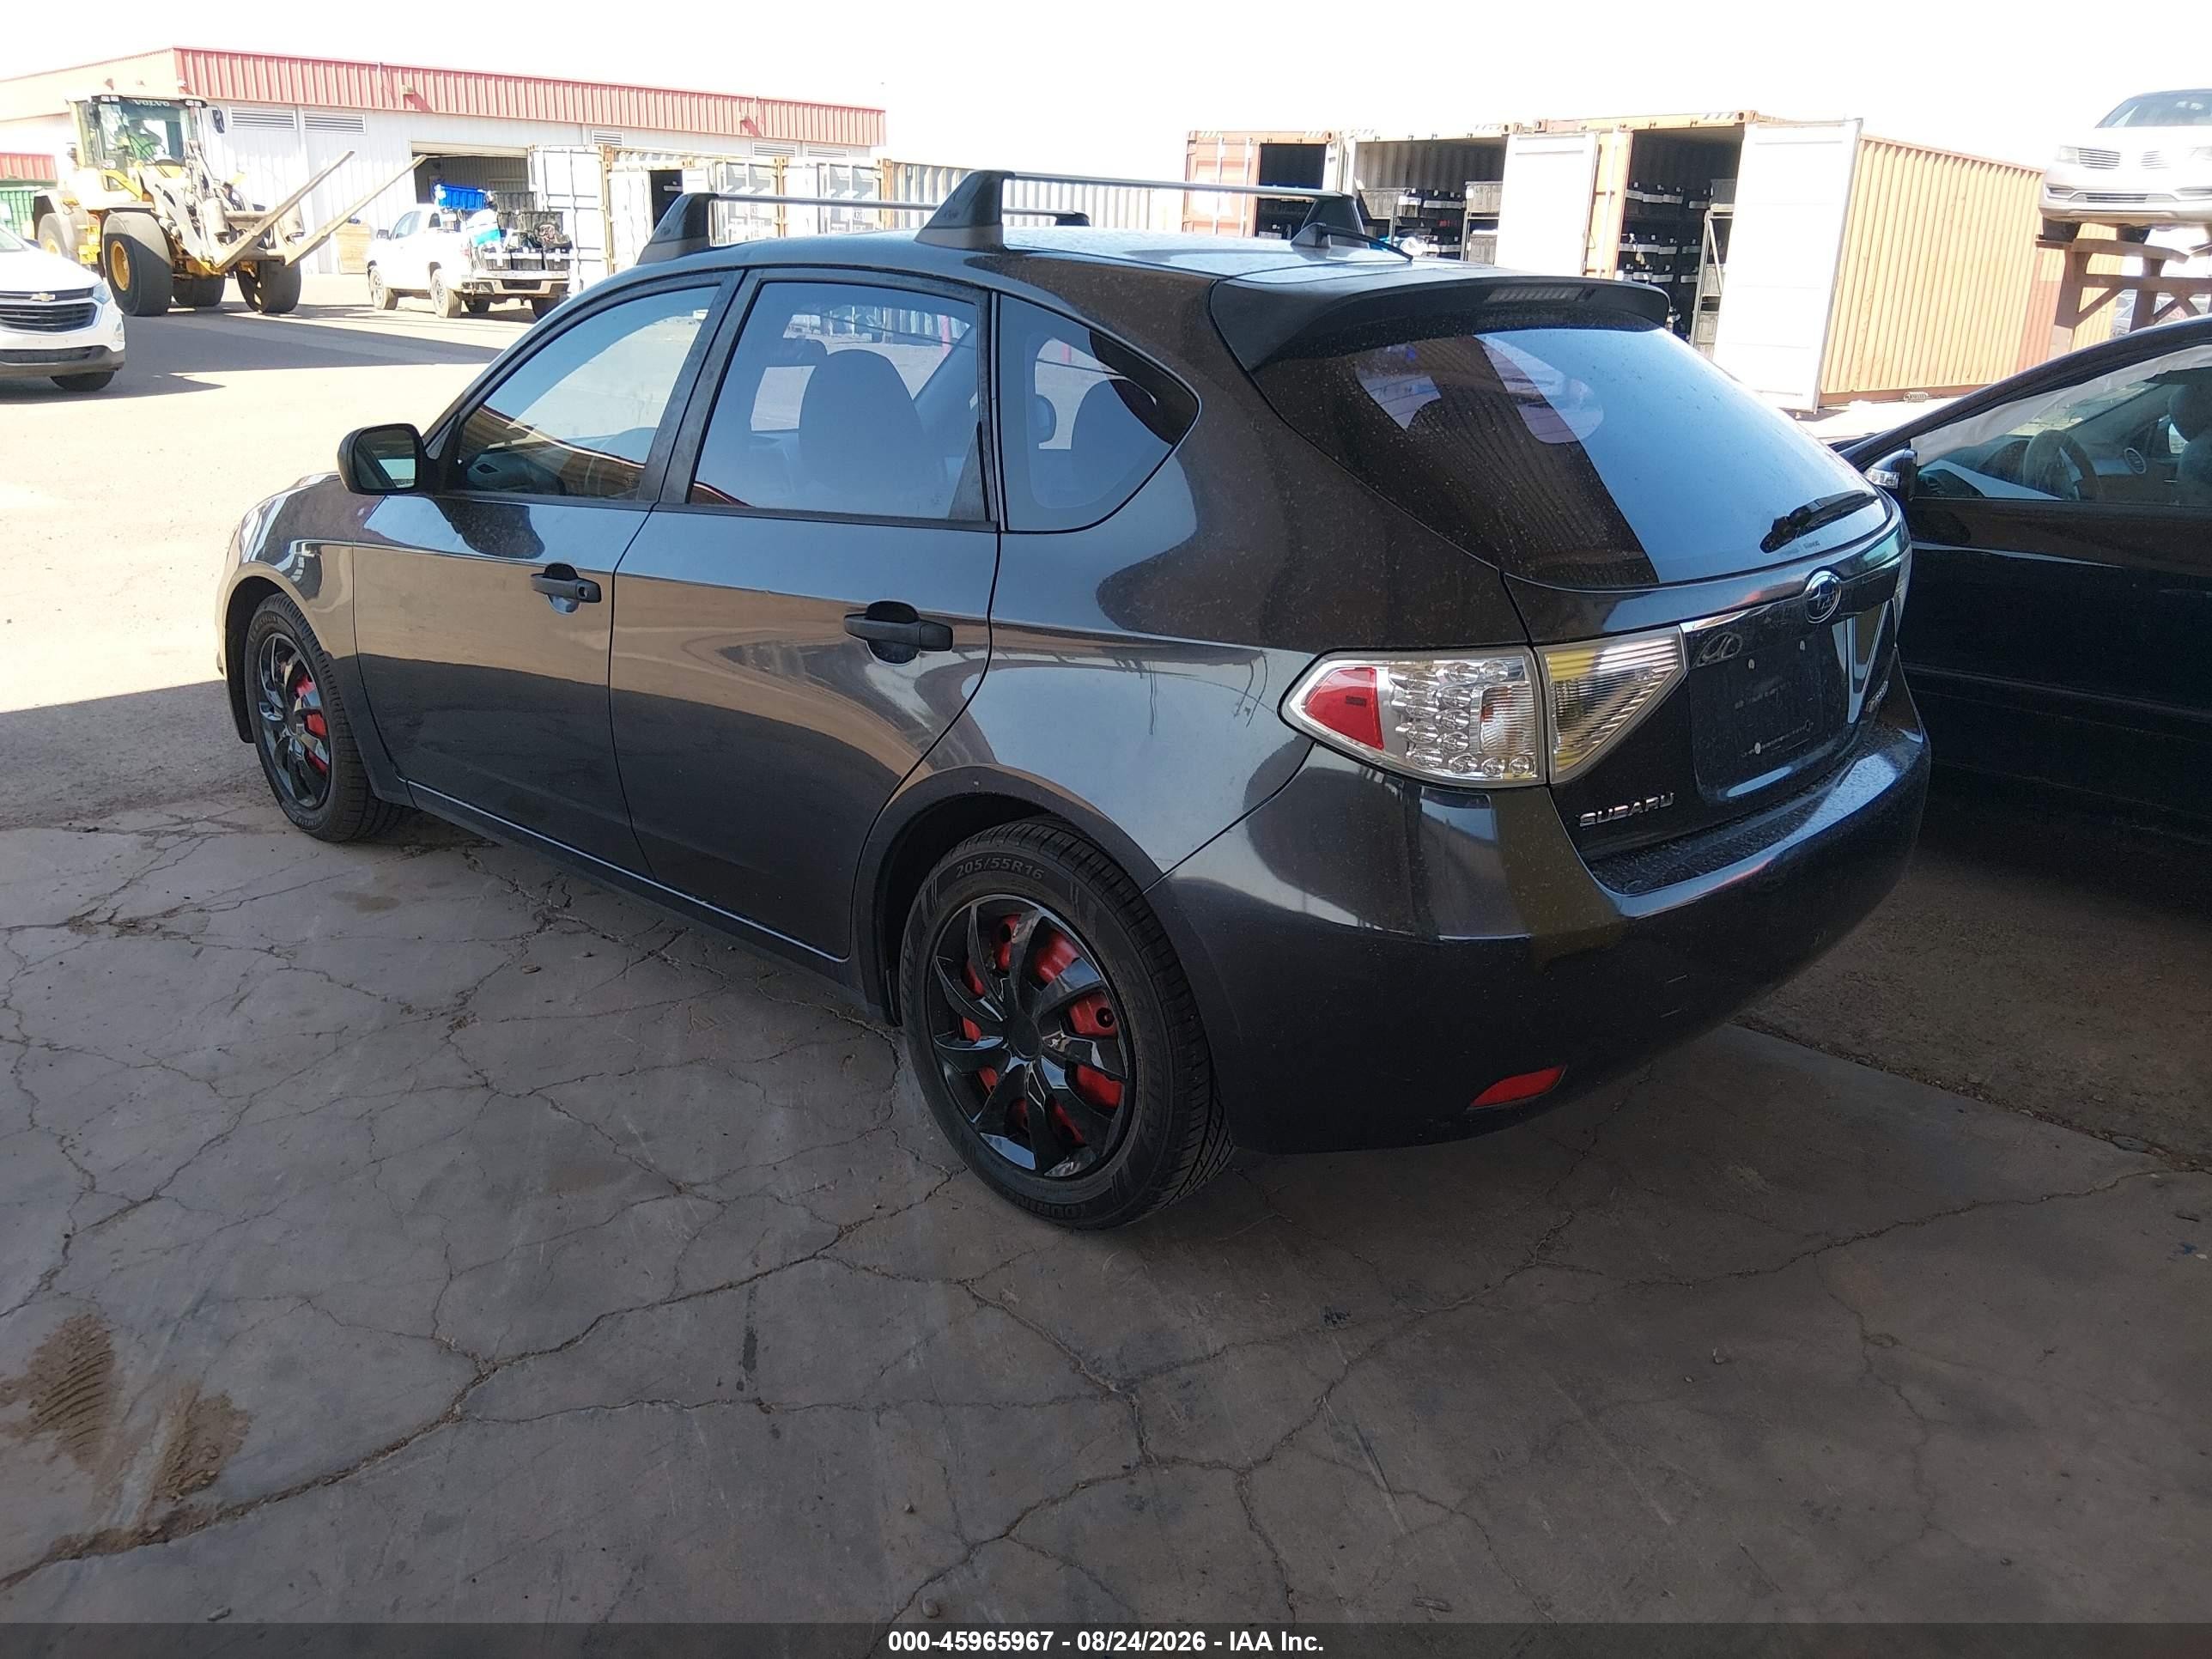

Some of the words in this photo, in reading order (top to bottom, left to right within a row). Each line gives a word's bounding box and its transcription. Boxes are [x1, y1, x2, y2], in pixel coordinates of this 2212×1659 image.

[132, 99, 170, 107] VOLVO
[1579, 792, 1674, 827] SUBARU
[956, 857, 1045, 879] 205/55R16
